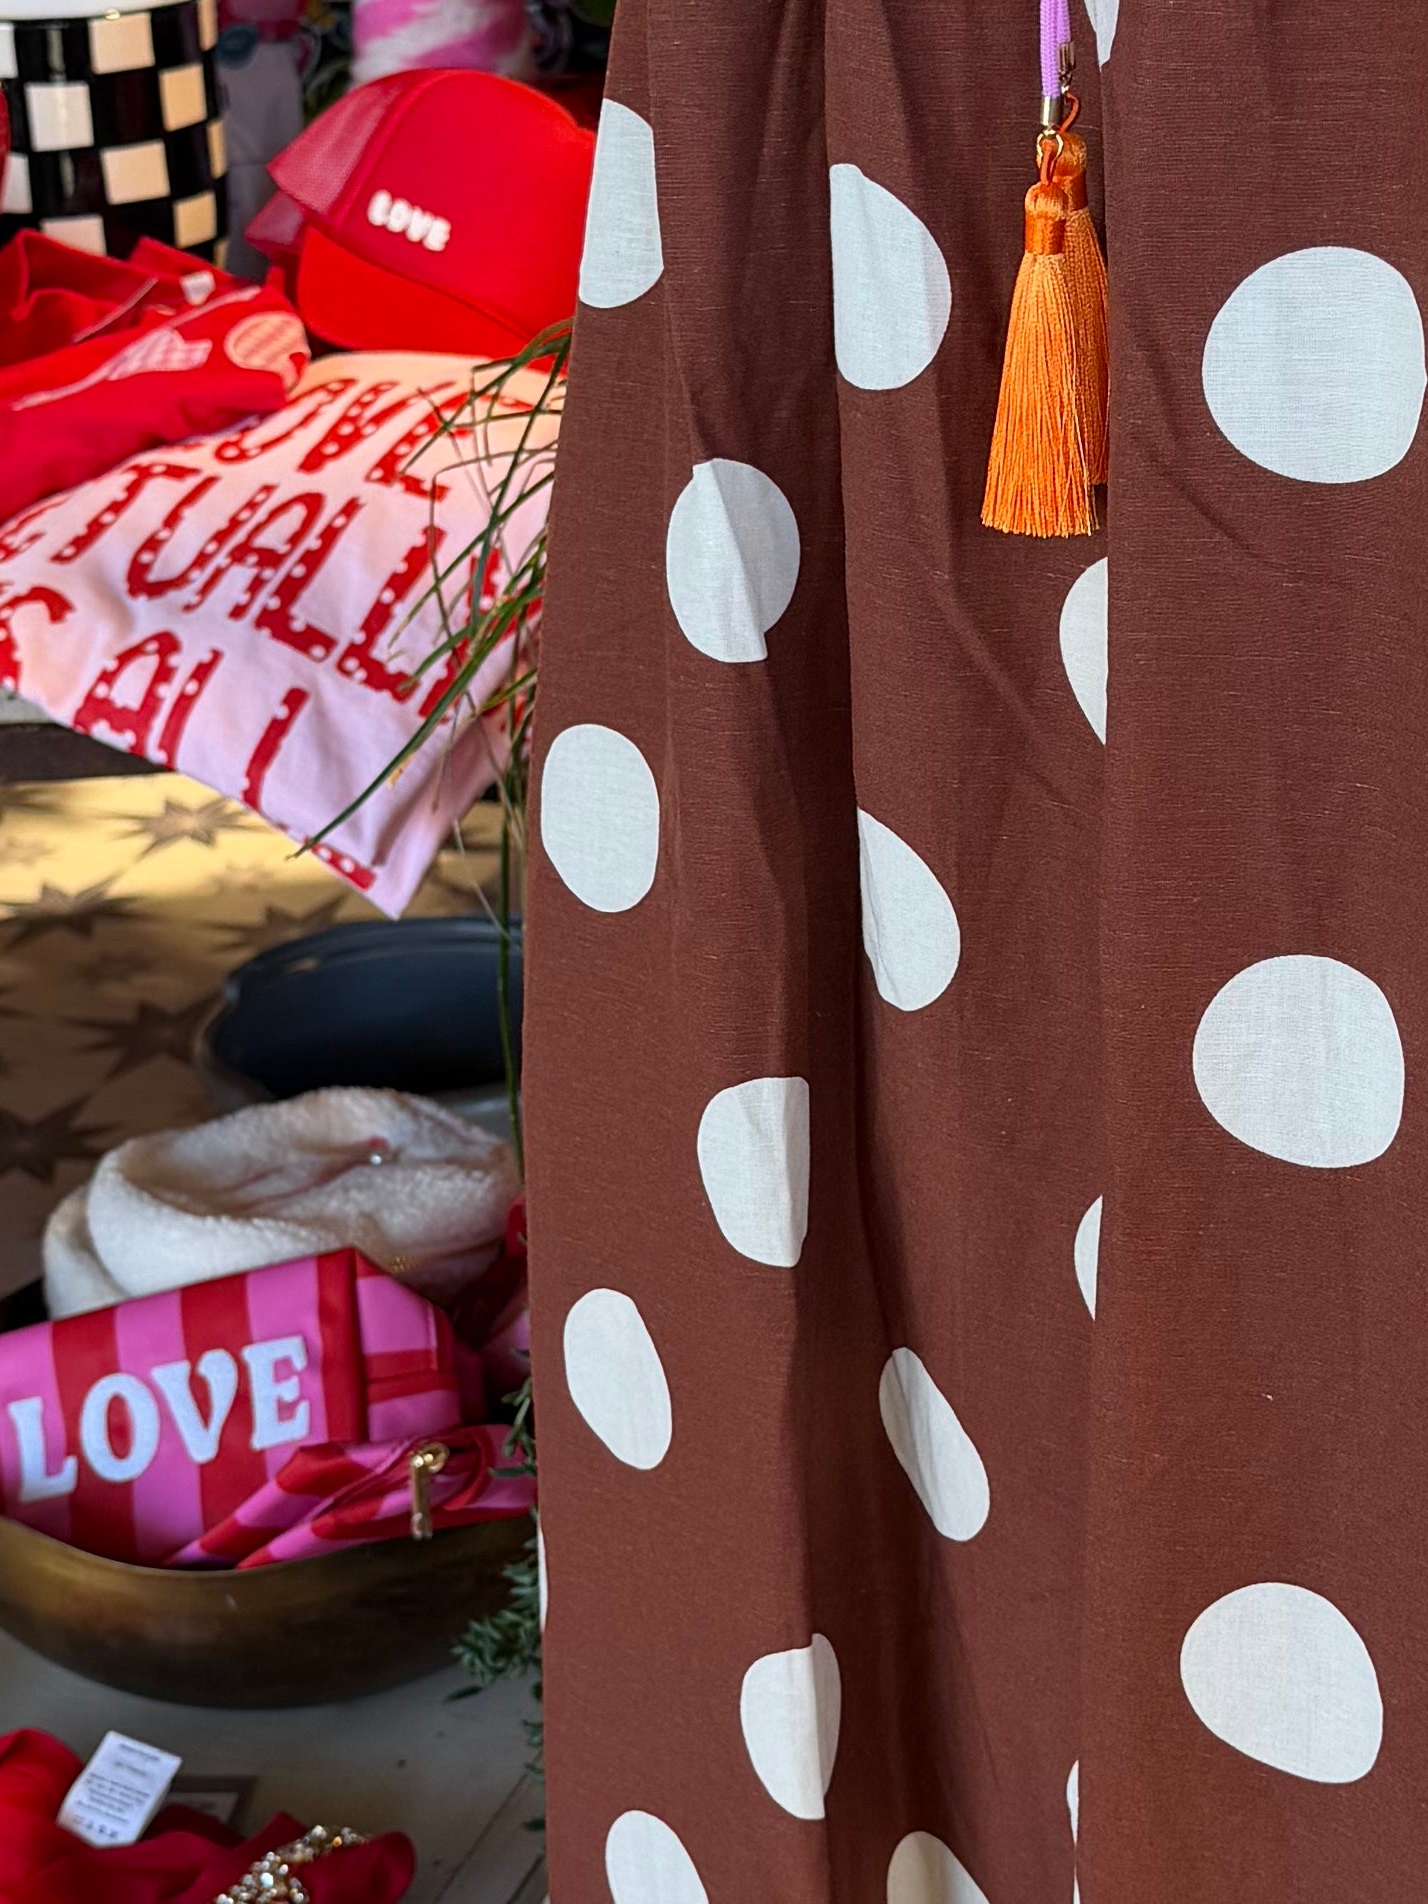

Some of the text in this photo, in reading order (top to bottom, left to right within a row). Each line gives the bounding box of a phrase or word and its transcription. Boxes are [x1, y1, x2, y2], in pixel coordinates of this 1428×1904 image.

[367, 188, 452, 252] LOVE
[177, 379, 540, 503] OVE
[8, 1335, 310, 1502] LOVE
